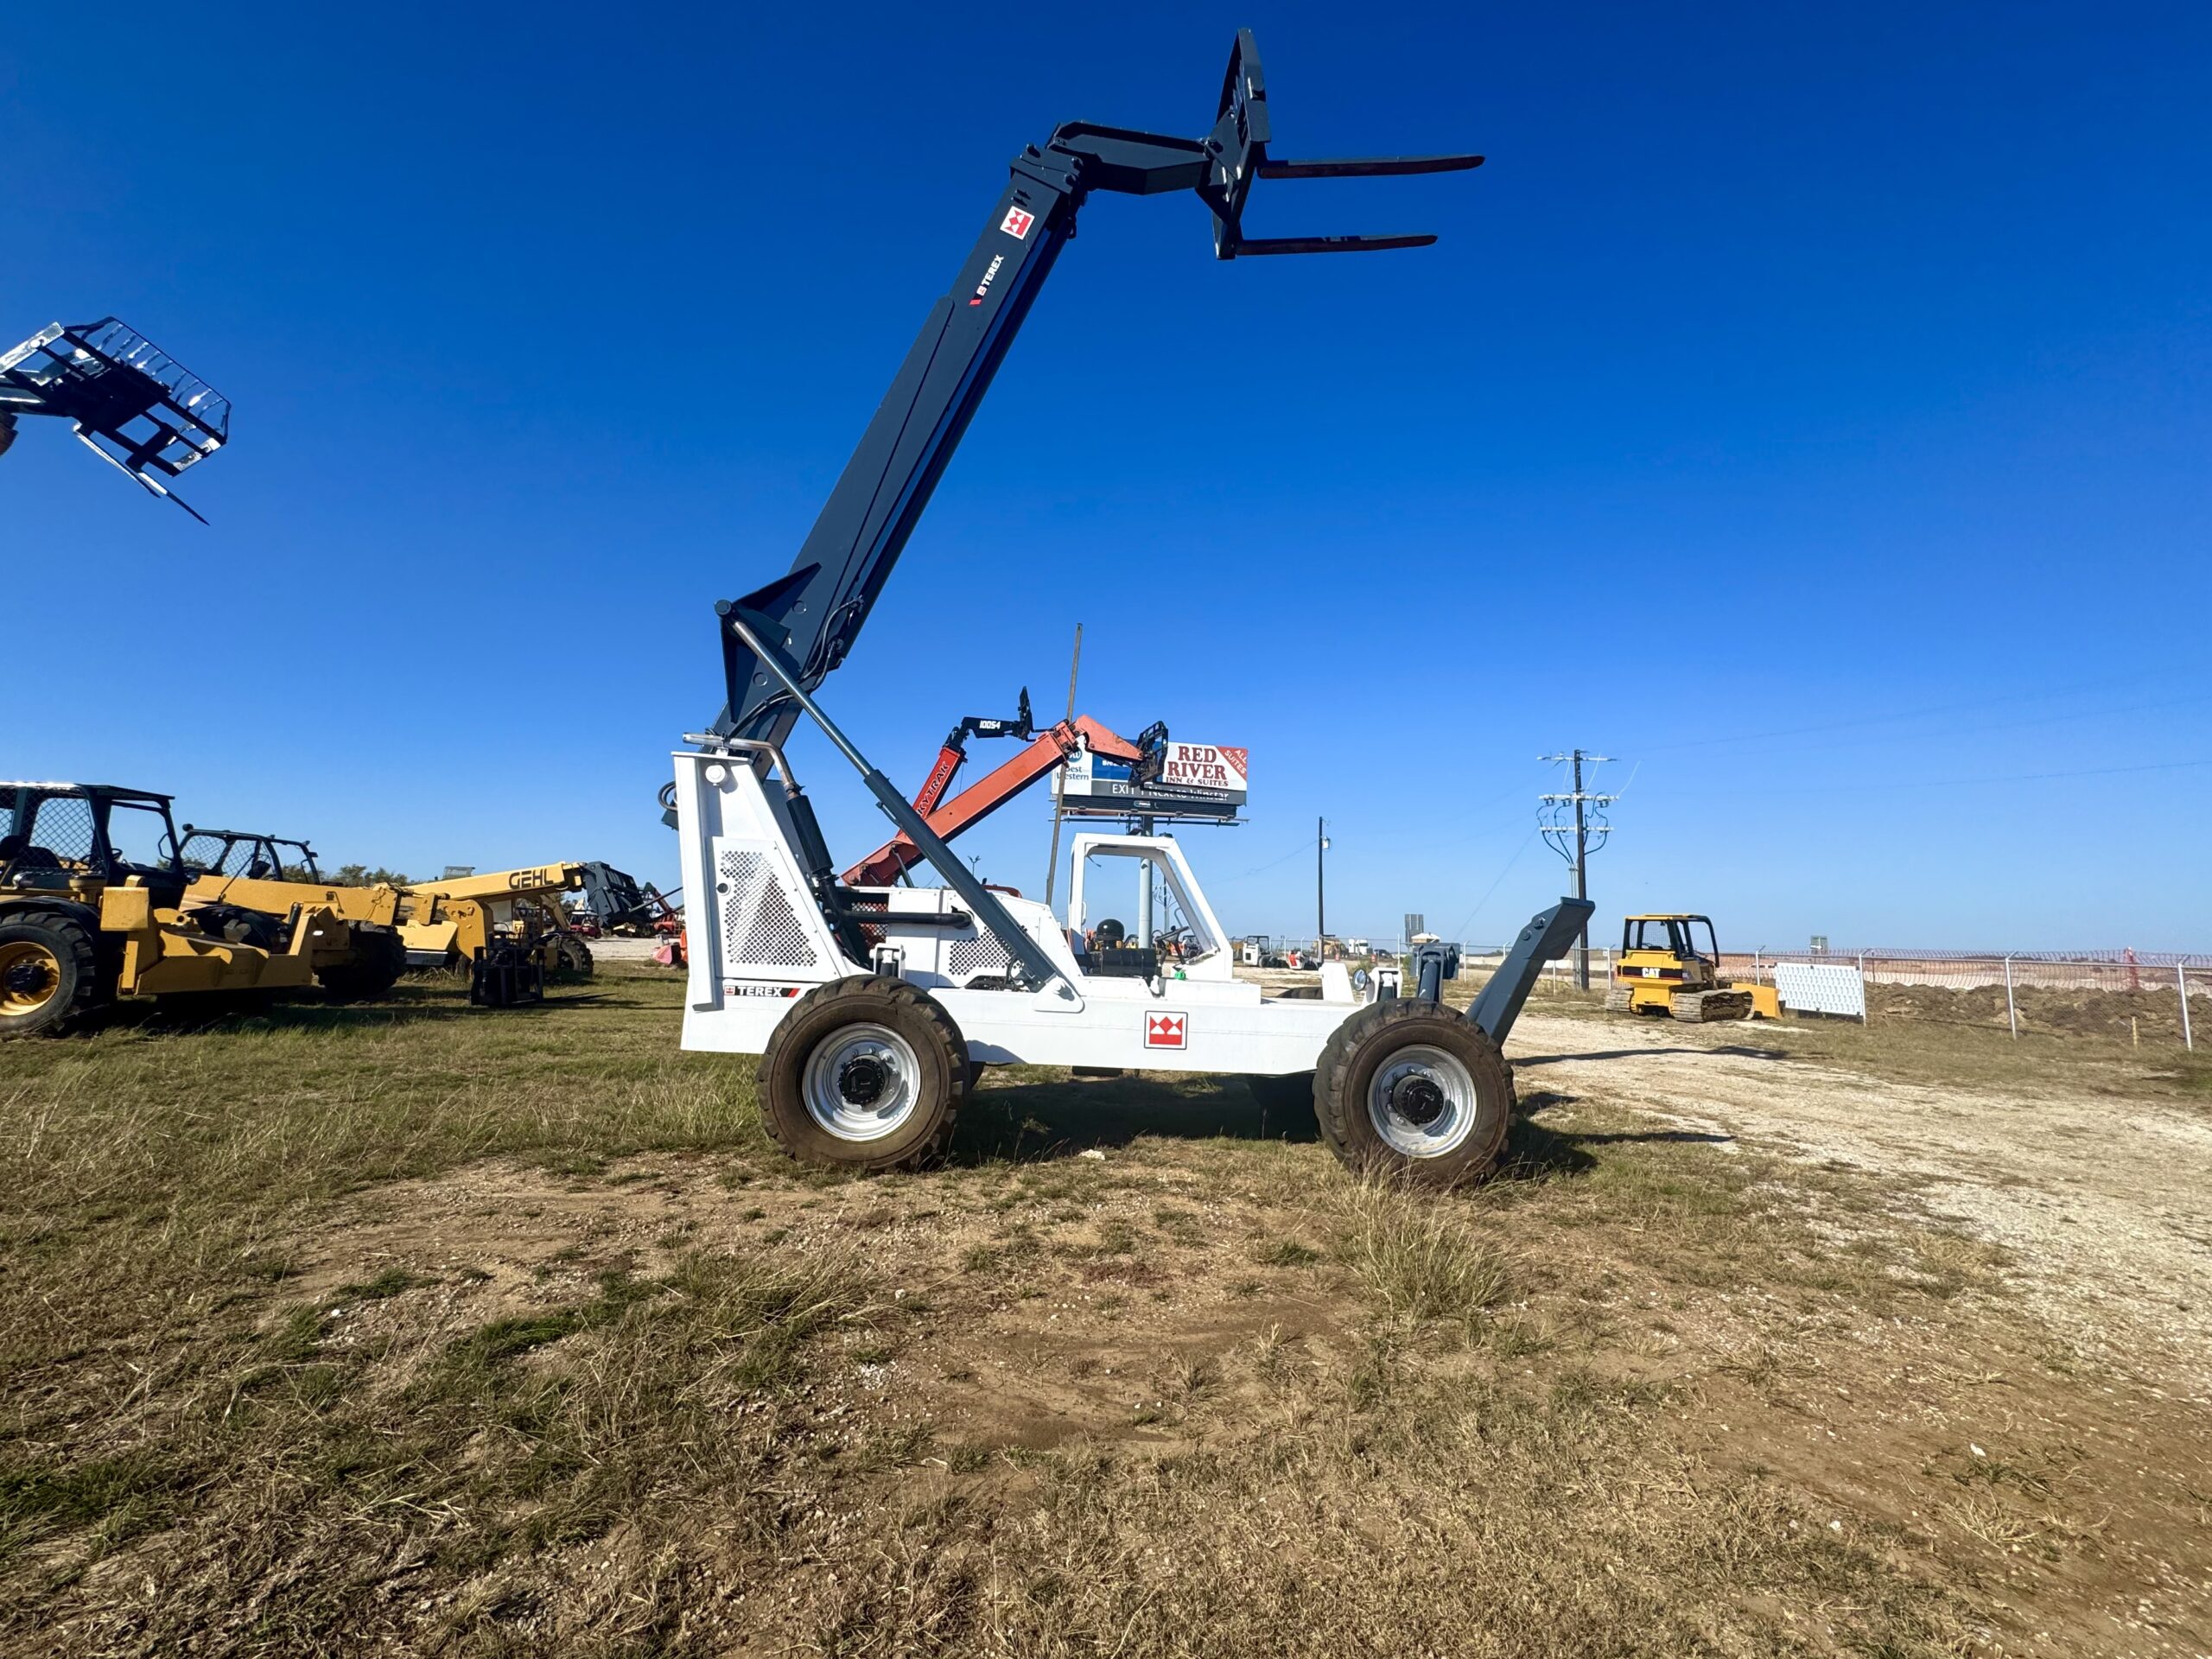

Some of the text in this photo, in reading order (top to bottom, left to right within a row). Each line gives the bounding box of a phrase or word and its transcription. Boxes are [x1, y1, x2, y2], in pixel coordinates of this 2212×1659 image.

[981, 254, 1004, 286] TEREX
[979, 720, 1001, 729] 10054
[1178, 746, 1217, 763] RED
[1224, 750, 1247, 774] SUITES
[1235, 749, 1247, 764] ALL
[1167, 761, 1227, 780] RIVER
[916, 760, 949, 817] KYTRAK
[1198, 779, 1229, 787] SUITES
[508, 868, 554, 889] GEHL
[1642, 967, 1661, 979] CAT
[737, 986, 783, 997] TEREX
